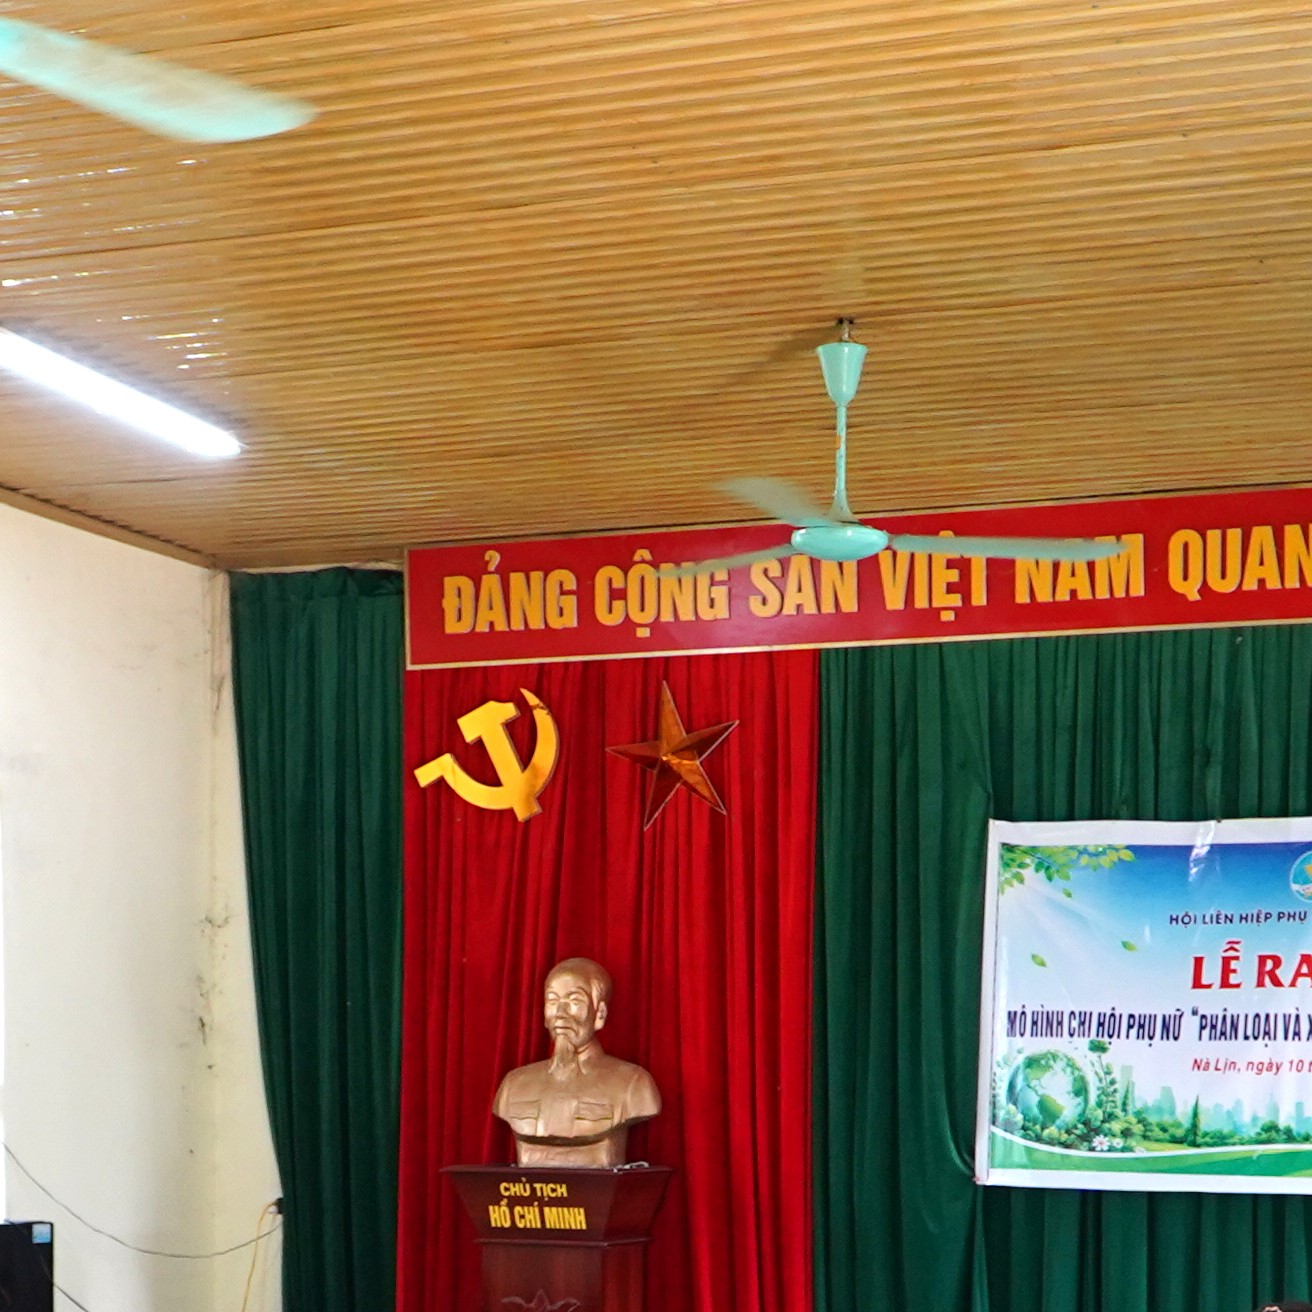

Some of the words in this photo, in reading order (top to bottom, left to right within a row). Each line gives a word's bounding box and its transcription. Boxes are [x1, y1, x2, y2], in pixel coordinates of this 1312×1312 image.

[442, 550, 577, 635] ĐẢNG
[593, 548, 730, 638] CỘNG
[877, 529, 988, 623] VIỆT
[1014, 533, 1146, 605] NAM
[1169, 910, 1198, 929] HỘI
[1201, 909, 1235, 925] LIÊN
[1238, 908, 1273, 928] HIỆP
[1276, 910, 1308, 925] PHỤ
[1190, 940, 1243, 990] LỄ
[1006, 1004, 1027, 1039] MÔ
[1030, 1004, 1064, 1039] HÌNH
[1068, 1010, 1092, 1040] CHI
[1096, 1006, 1122, 1046] HỘI
[1127, 1012, 1156, 1048] PHỤ
[1160, 1008, 1184, 1042] NỮ
[1243, 1013, 1278, 1048] LOẠI
[1283, 1006, 1302, 1042] VÀ
[1191, 1058, 1211, 1073] Nà
[1245, 1057, 1283, 1076] ngày
[1287, 1059, 1304, 1073] 10
[499, 1177, 531, 1197] CHỦ
[533, 1183, 568, 1201] TỊCH
[488, 1198, 512, 1229] HỒ
[513, 1201, 542, 1229] CHÍ
[543, 1206, 587, 1230] MINH
